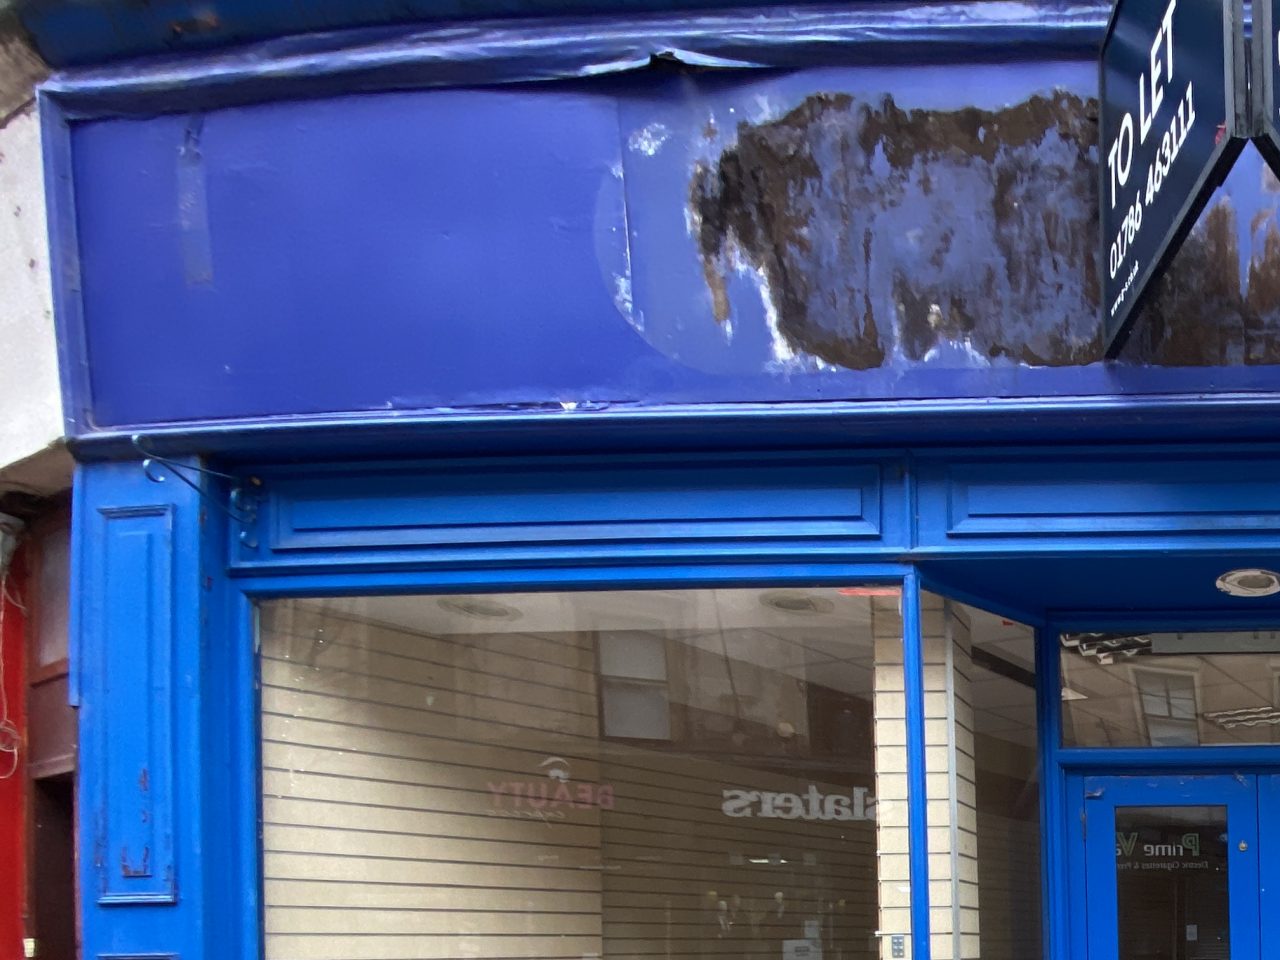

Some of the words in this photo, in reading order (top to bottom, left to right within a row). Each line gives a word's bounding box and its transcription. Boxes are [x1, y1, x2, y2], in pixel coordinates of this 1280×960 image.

[1108, 112, 1134, 209] TO
[1139, 0, 1176, 144] LET
[1109, 191, 1142, 279] 01786
[1145, 81, 1196, 206] 463111
